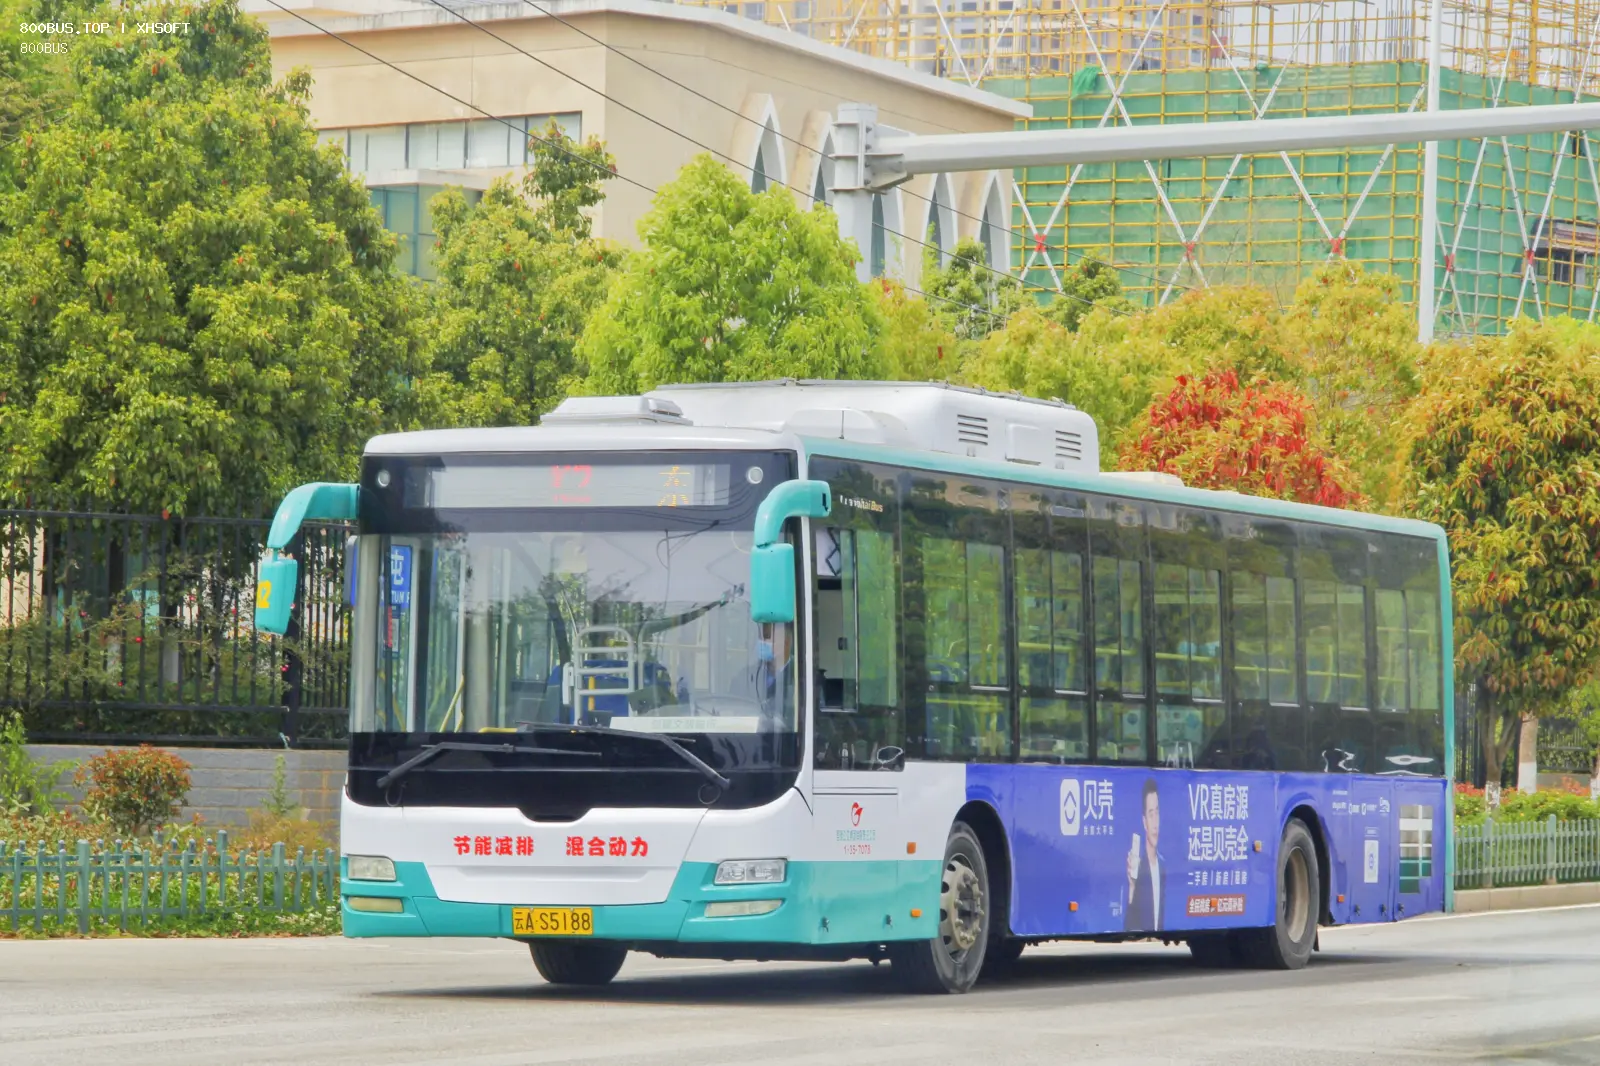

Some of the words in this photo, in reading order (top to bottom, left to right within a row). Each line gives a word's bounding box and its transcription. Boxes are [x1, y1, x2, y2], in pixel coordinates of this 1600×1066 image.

[1083, 779, 1113, 820] 贝壳
[1188, 784, 1249, 820] VR真房源
[453, 836, 535, 857] 节能减排
[566, 836, 649, 857] 混合动力
[1188, 825, 1249, 861] 还是贝壳全
